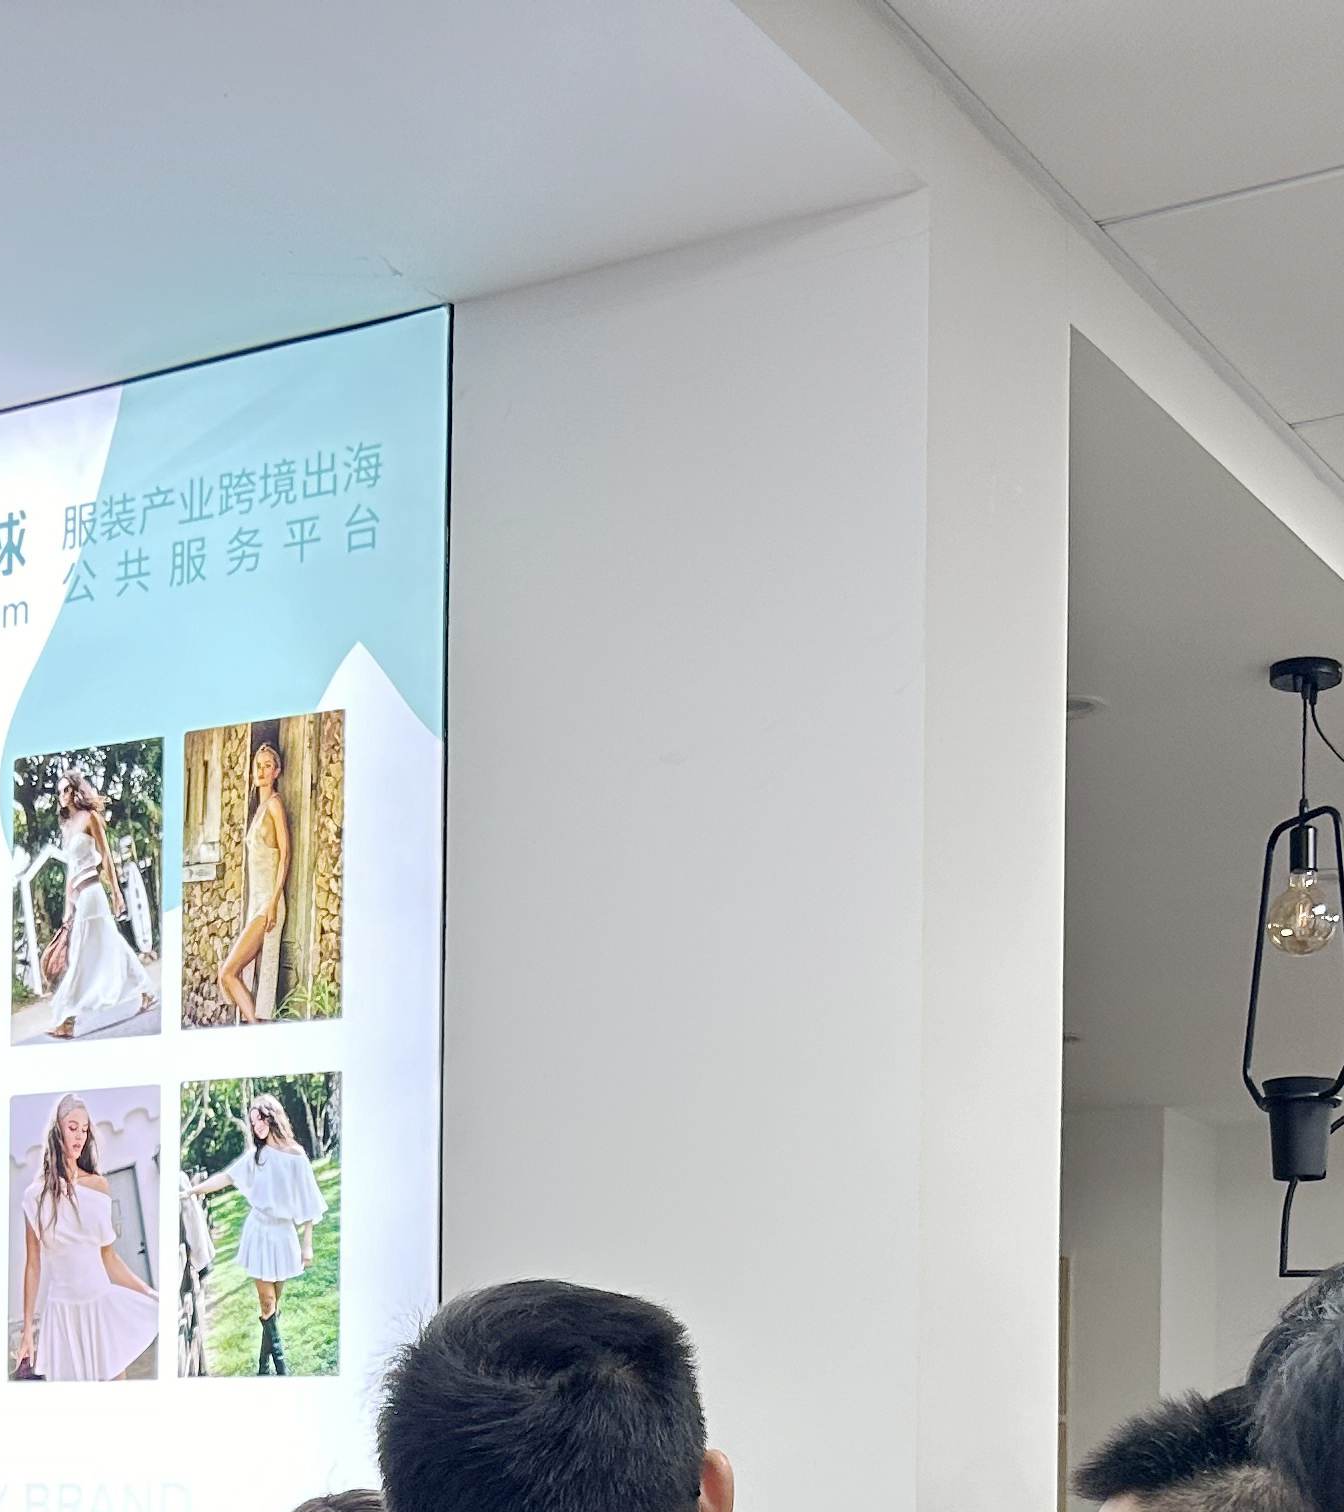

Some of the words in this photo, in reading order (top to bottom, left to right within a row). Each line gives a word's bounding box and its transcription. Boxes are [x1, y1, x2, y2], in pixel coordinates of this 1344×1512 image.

[62, 441, 382, 550] 服装产业跨境出海
[62, 503, 380, 604] 公共服务平台
